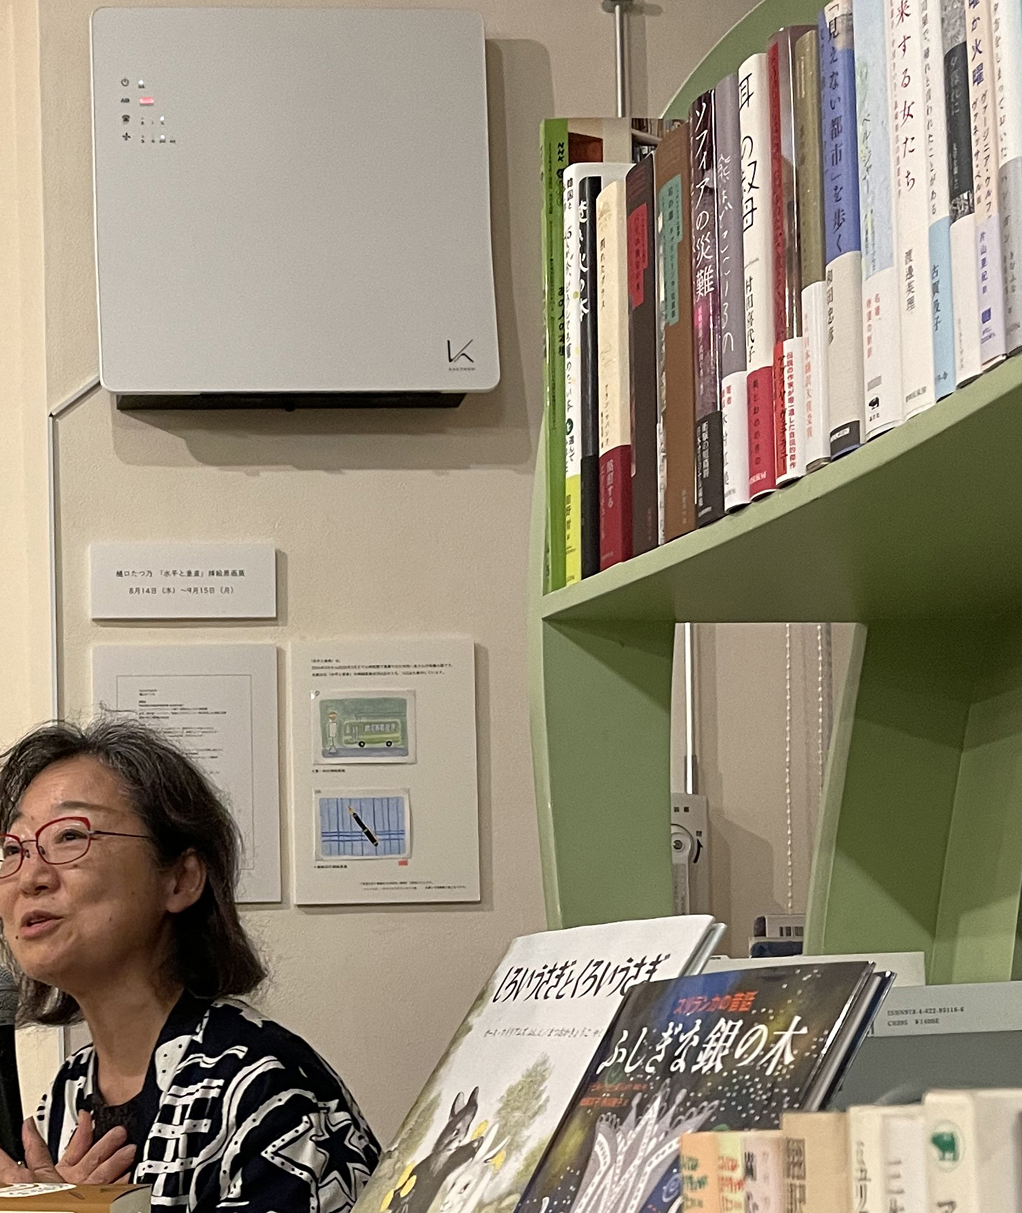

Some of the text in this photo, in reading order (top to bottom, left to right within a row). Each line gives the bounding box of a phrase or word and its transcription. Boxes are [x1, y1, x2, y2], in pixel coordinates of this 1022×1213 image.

[695, 102, 716, 298] ソフィアの災難
[739, 73, 760, 233] 耳の叔母
[492, 953, 671, 1004] しろいうさぎとくろいうさぎ
[596, 1015, 809, 1077] ふしぎな銀の木
